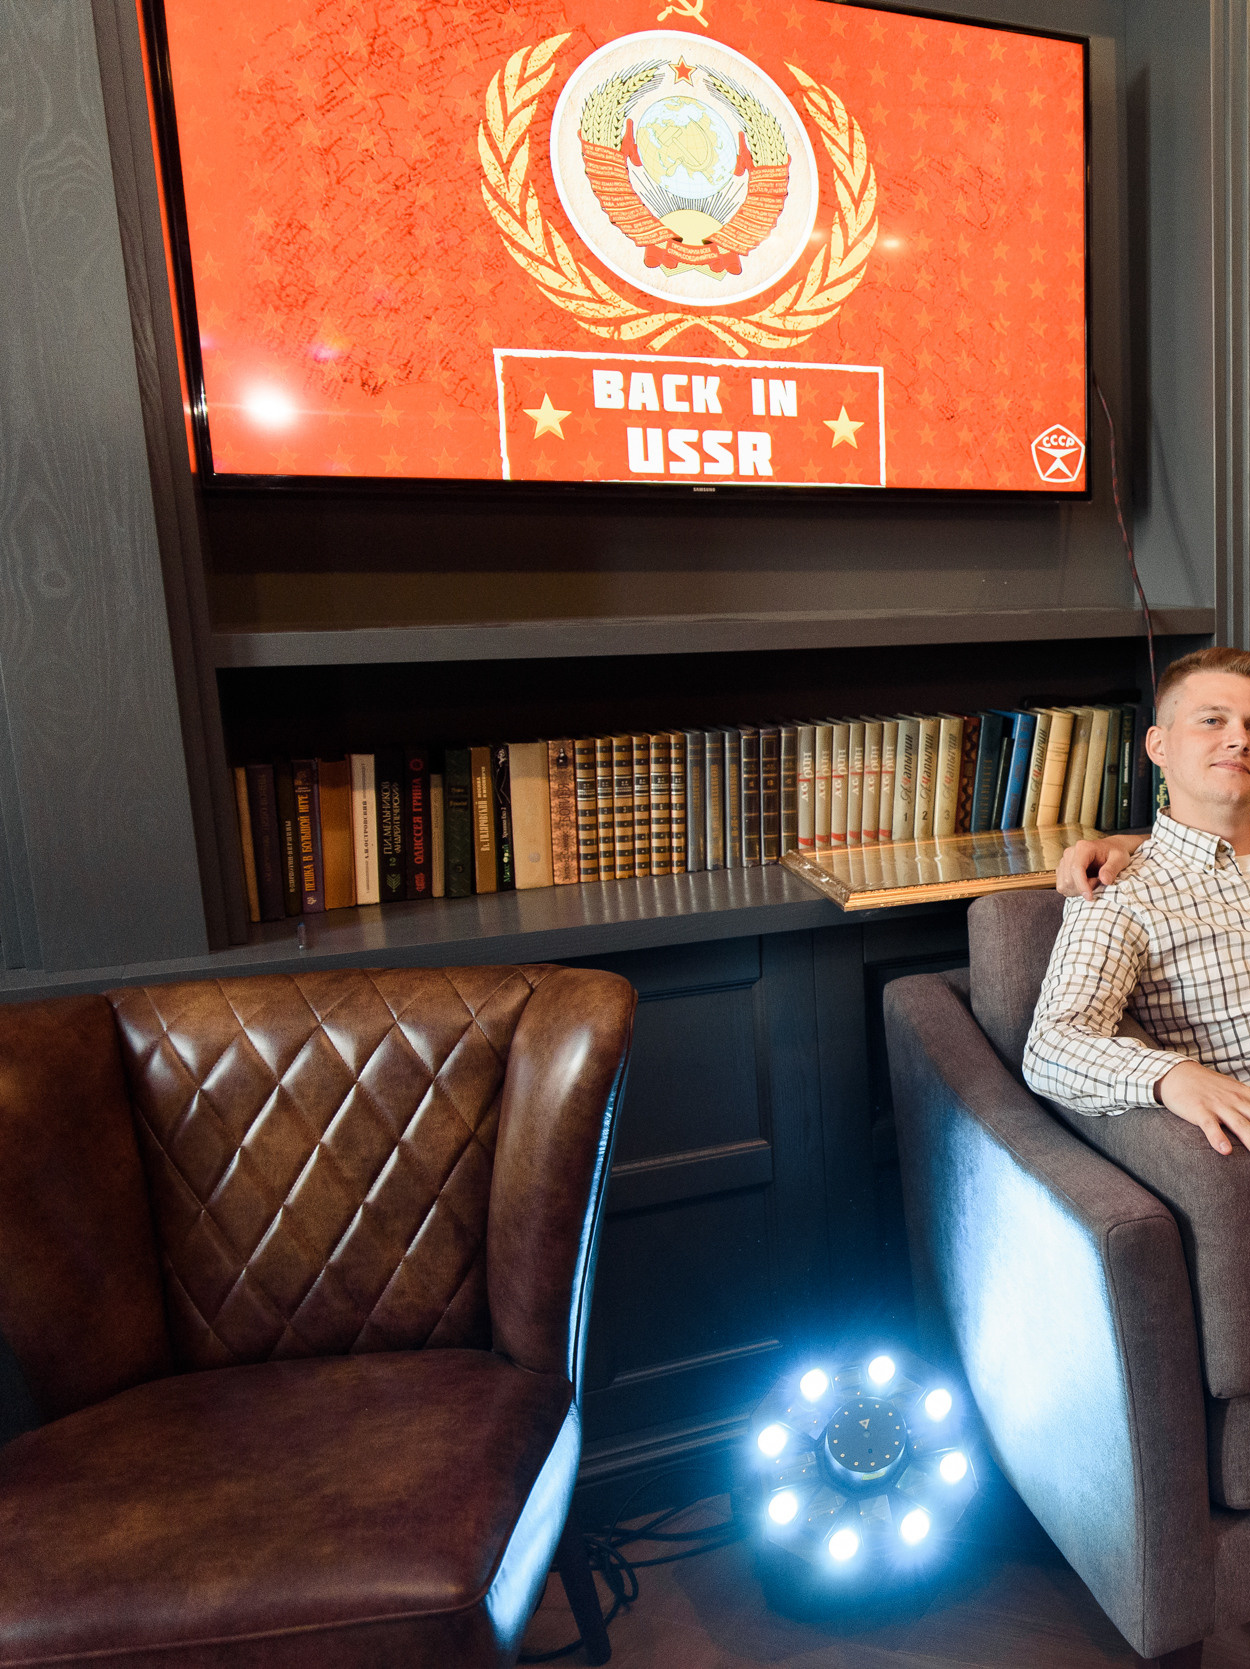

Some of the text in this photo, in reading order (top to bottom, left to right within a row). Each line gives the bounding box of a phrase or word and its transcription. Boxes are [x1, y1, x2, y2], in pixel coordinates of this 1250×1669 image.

[592, 369, 799, 418] BACK IN
[626, 426, 775, 477] USSR
[1042, 434, 1076, 447] СССР
[297, 794, 310, 813] ИГРЕ
[1030, 802, 1036, 813] 5
[411, 776, 425, 865] ОДИССЕЯ ГРИНА
[475, 800, 490, 842] ГИЛЯРОВСКИЙ
[904, 812, 908, 822] 1
[922, 810, 929, 821] 2
[297, 815, 313, 853] БОЛЬШОЙ
[388, 856, 397, 867] 2
[302, 864, 316, 891] ПЕШКА
